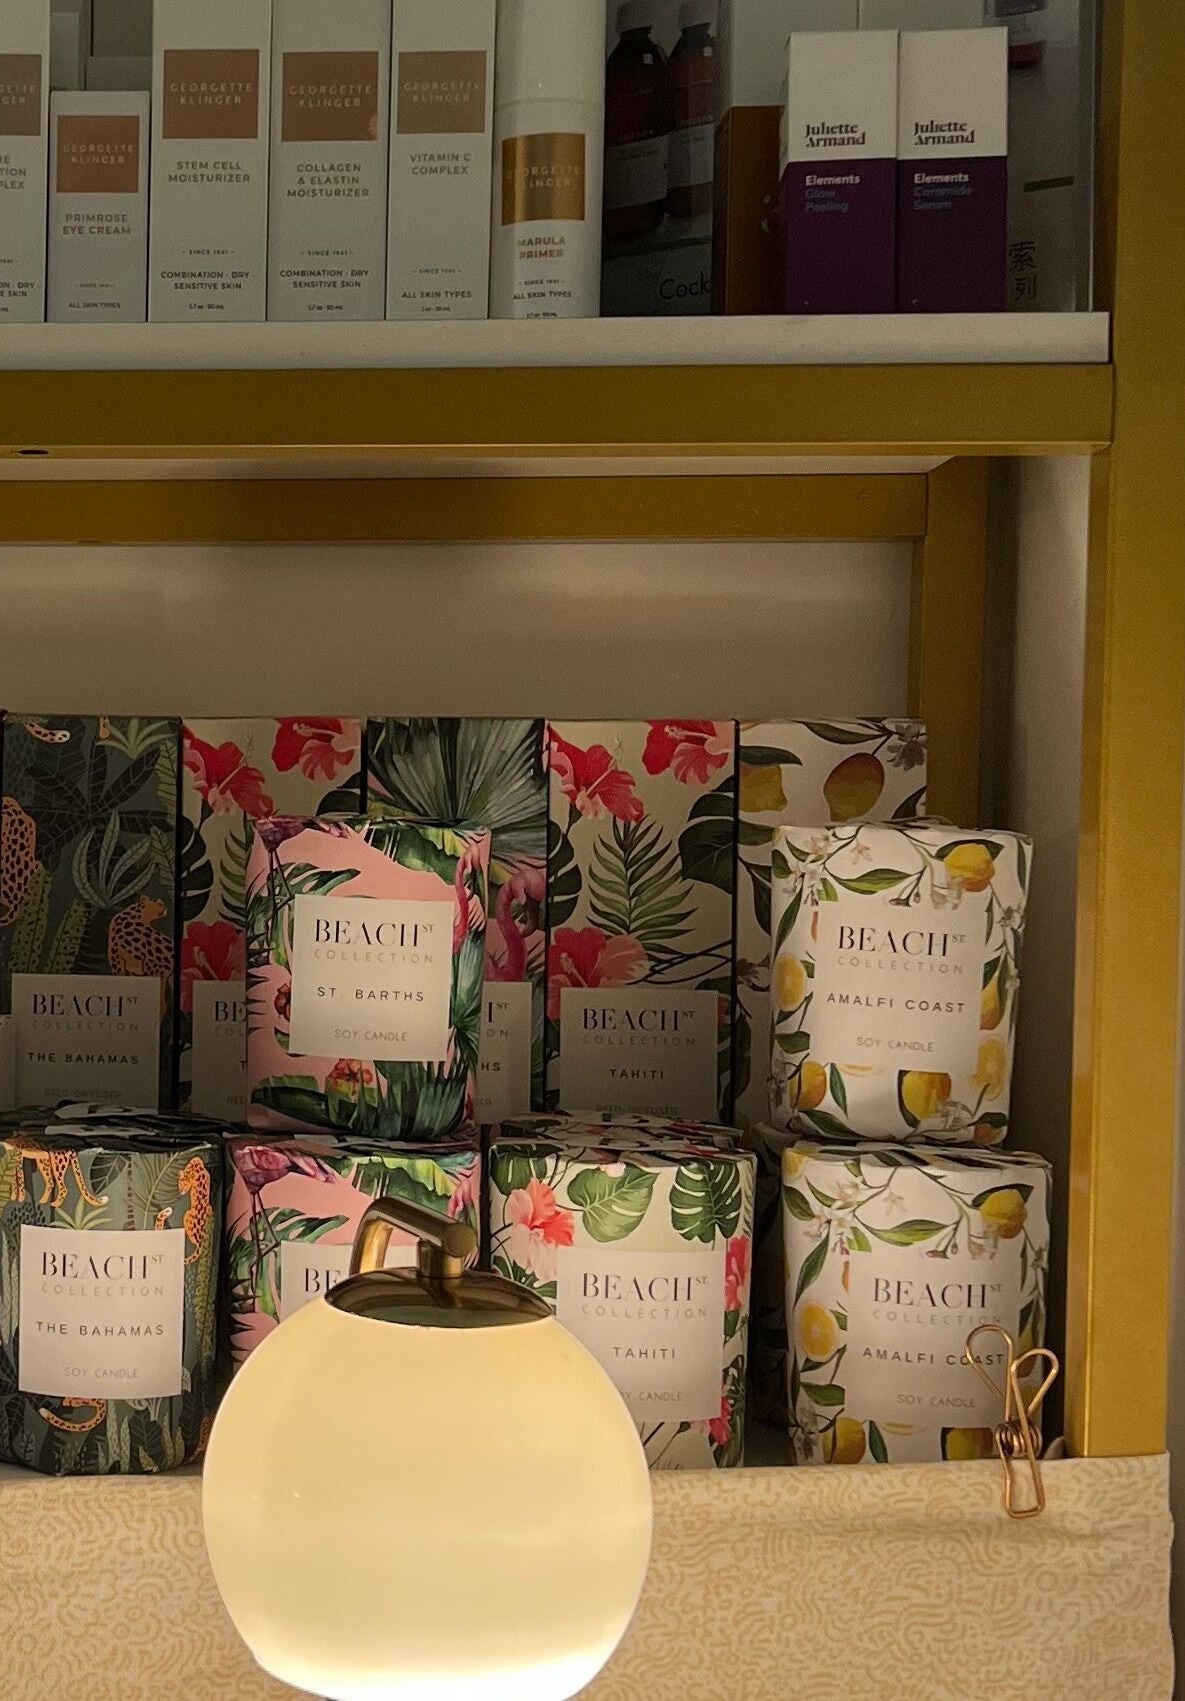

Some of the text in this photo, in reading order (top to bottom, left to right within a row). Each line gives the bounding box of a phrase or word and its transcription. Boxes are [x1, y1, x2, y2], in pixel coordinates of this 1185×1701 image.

[169, 81, 253, 93] GEORGETTE
[288, 84, 372, 96] GEORGETTE
[400, 80, 479, 92] GEORGETTE
[180, 95, 242, 105] KLINGER
[298, 97, 361, 108] KLINGER
[805, 121, 859, 138] Juliette
[914, 119, 968, 135] Juliette
[806, 131, 866, 147] Armand
[914, 130, 975, 146] Armand
[64, 143, 134, 154] GEORGETTE
[71, 155, 126, 166] KLINGER
[409, 152, 471, 163] VITAMIN C
[176, 161, 242, 171] STEM CELL
[296, 163, 361, 173] COLLAGEN
[411, 166, 469, 176] COMPLEX
[168, 173, 251, 183] MOISTURIZER
[297, 175, 360, 185] & ELASTIN
[806, 174, 861, 187] Elements
[914, 172, 970, 184] Elements
[286, 187, 369, 198] MOISTURIZER
[65, 213, 128, 223] PRIMROSE
[62, 225, 132, 236] EYE CREAM
[517, 236, 566, 248] MARULA
[519, 249, 564, 261] PRIMER
[160, 270, 250, 279] COMBINATION DRY
[279, 269, 369, 278] COMBINATION DRY
[17, 281, 35, 290] DRY
[173, 281, 242, 290] SENSITIVE SKIN
[293, 280, 361, 289] SENSITIVE SKIN
[8, 290, 28, 298] SKIN
[401, 291, 472, 299] ALL SKIN TYPES
[315, 918, 419, 947] BEACH
[838, 925, 948, 958] BEACH
[313, 949, 433, 964] COLLECTION
[837, 955, 964, 975] COLLECTION
[355, 988, 425, 1002] BARTHS
[32, 993, 124, 1017] BEACH
[826, 992, 965, 1013] AMALFI COAST
[32, 1019, 139, 1032] COLLECTION
[583, 1008, 678, 1031] BEACH
[334, 1028, 408, 1043] SOY CANDLE
[582, 1034, 696, 1047] COLLECTION
[856, 1036, 934, 1053] SOY CANDLE
[28, 1051, 140, 1065] THE BAHAMAS
[609, 1068, 664, 1080] TAHITI
[42, 1251, 147, 1280] BEACH
[41, 1282, 164, 1297] COLLECTION
[582, 1272, 693, 1301] BEACH
[872, 1277, 986, 1309] BEACH
[582, 1303, 707, 1319] COLLECTION
[872, 1308, 1002, 1325] COLLECTION
[36, 1320, 165, 1337] THE BAHAMAS
[612, 1346, 677, 1360] TAHITI
[862, 1346, 1004, 1366] AMALFI COAST
[64, 1366, 139, 1379] SOY CANDLE
[639, 1391, 682, 1401] CANDLE
[896, 1393, 976, 1409] SOY CANDLE
